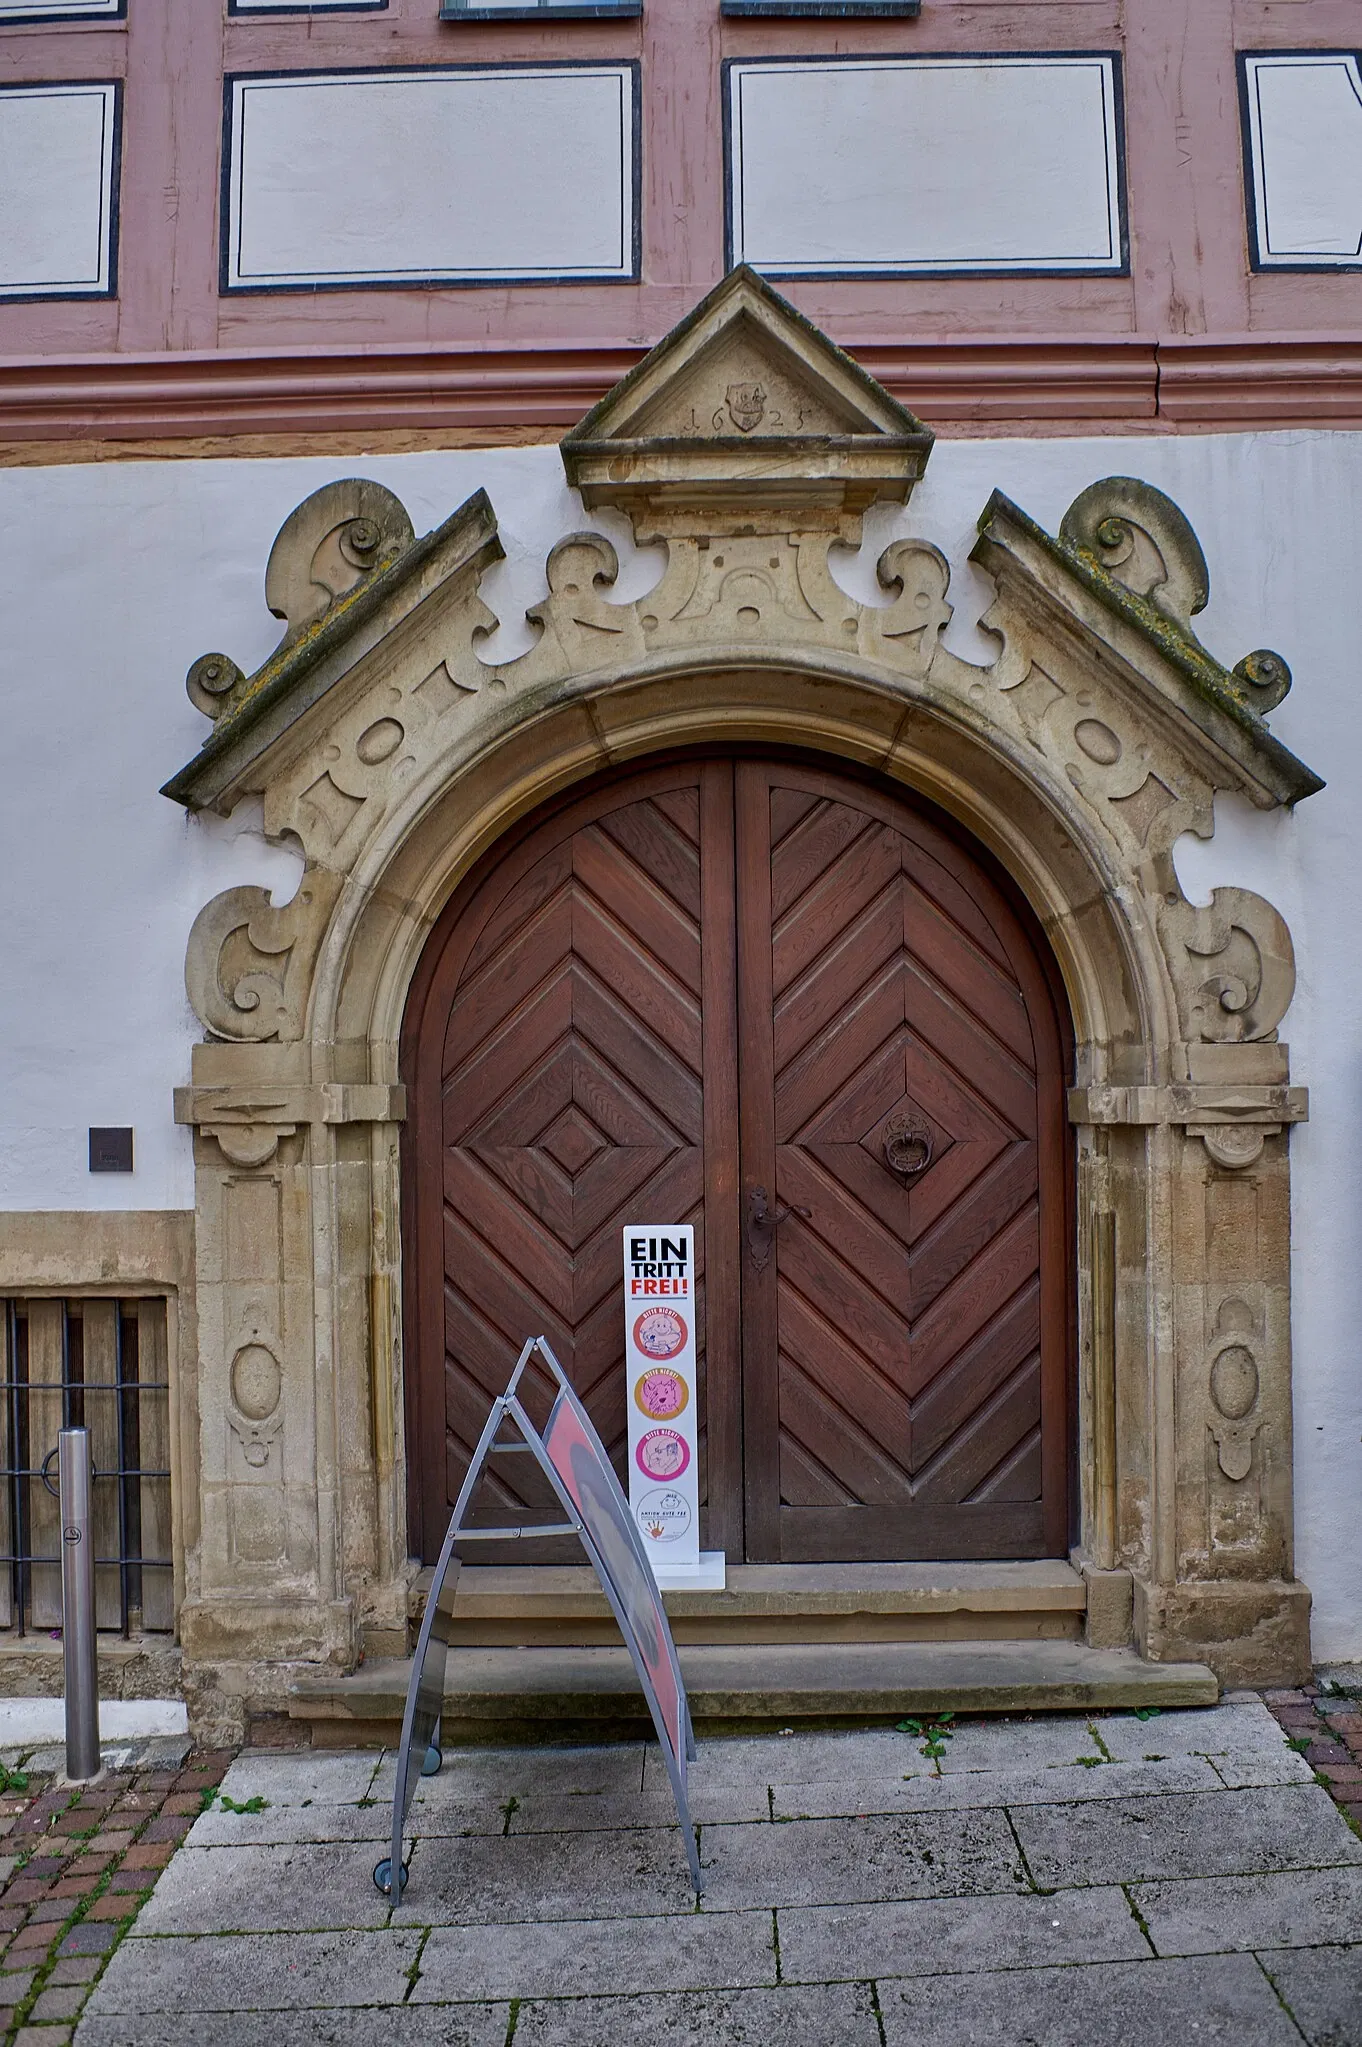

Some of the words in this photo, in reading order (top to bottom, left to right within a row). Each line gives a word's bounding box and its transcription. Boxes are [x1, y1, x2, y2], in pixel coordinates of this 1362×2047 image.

[630, 1237, 687, 1261] EIN
[631, 1262, 687, 1278] TRITT
[631, 1278, 688, 1294] FREI!
[643, 1308, 657, 1319] BITTE
[658, 1308, 678, 1318] NICHT!
[644, 1370, 658, 1380] BITTE
[660, 1370, 679, 1379] NICHT!
[645, 1430, 659, 1440] BITTE
[661, 1430, 680, 1439] NICHT!
